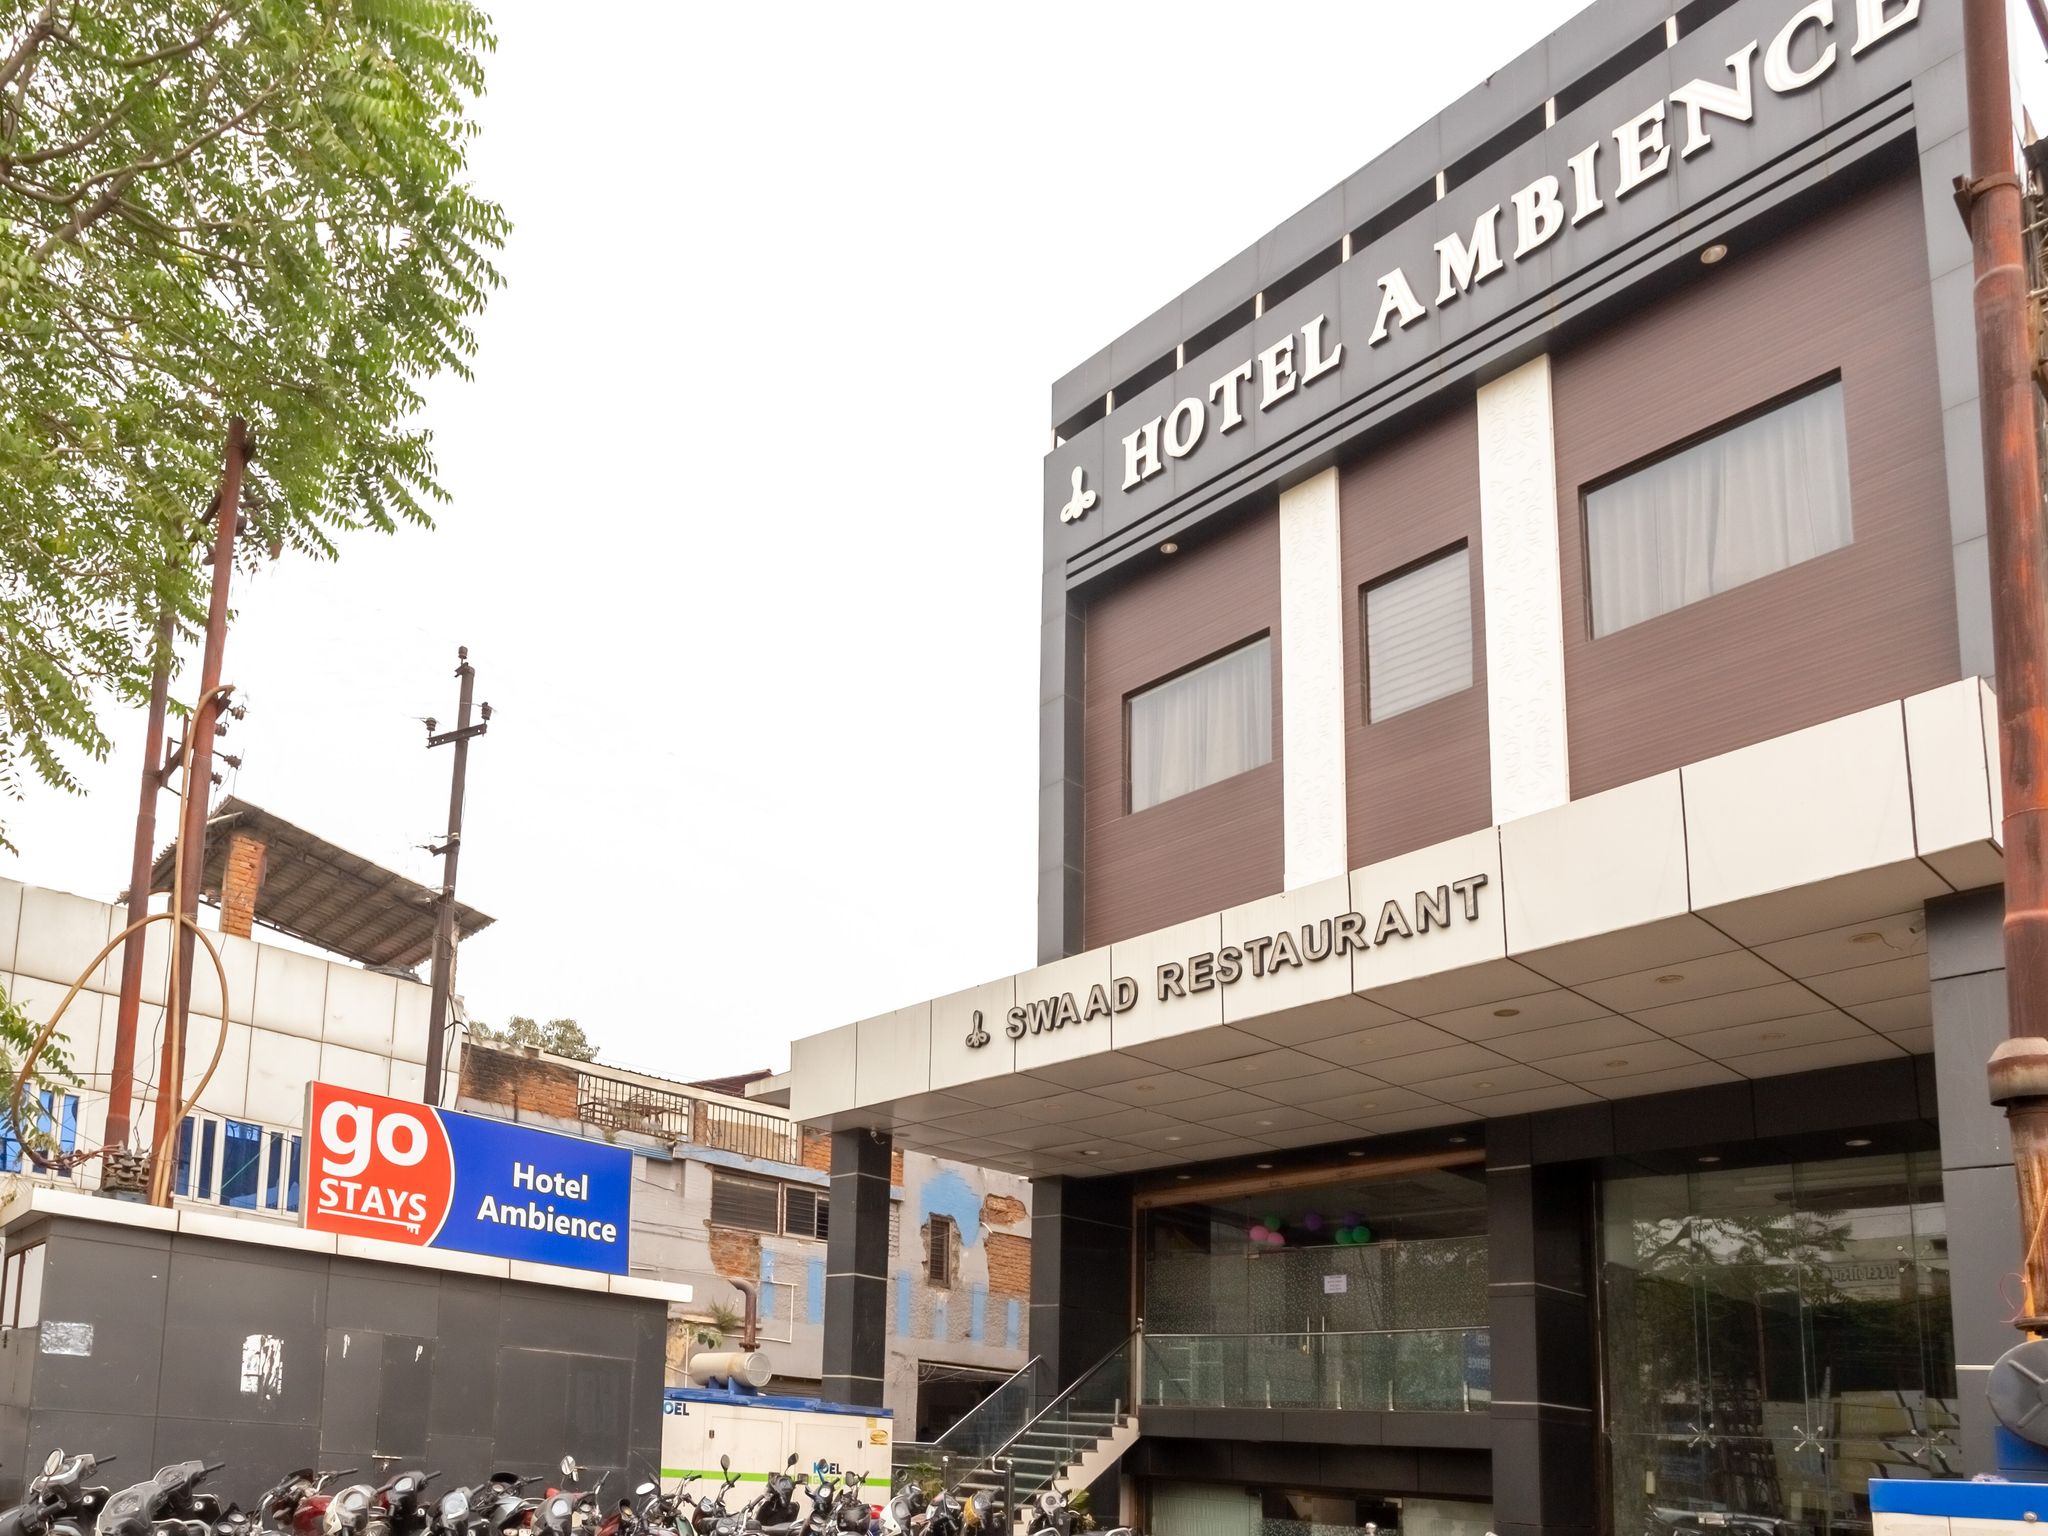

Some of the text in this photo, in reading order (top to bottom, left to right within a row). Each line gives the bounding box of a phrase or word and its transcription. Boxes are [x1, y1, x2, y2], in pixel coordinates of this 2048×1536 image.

[1121, 313, 1344, 492] HOTEL
[1005, 873, 1488, 1040] SWAAD RESTAURANT
[319, 1100, 429, 1178] go
[318, 1178, 427, 1222] STAYS
[512, 1161, 589, 1202] Hotel
[476, 1194, 617, 1243] Ambience
[664, 1401, 690, 1416] OEL
